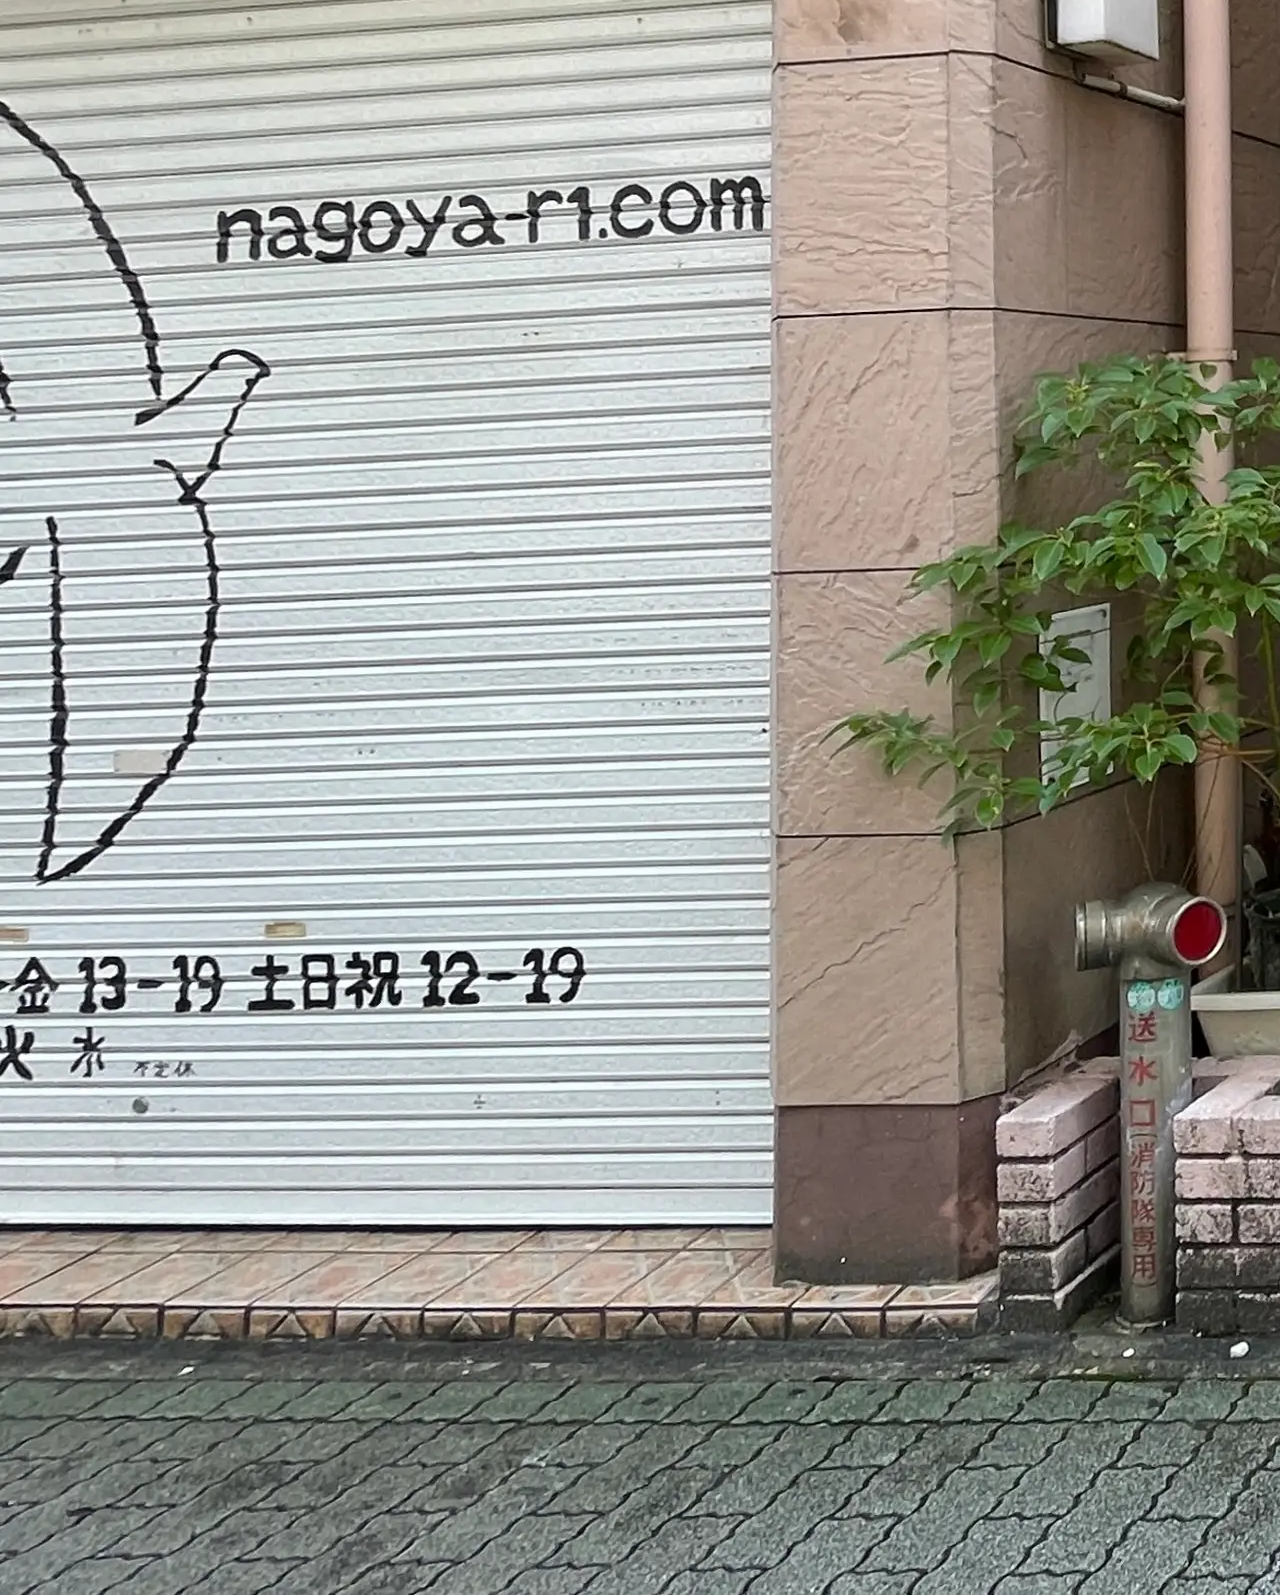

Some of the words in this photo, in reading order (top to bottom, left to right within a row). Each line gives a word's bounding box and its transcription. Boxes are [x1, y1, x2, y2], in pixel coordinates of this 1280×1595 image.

[216, 174, 769, 264] nagoya-r1.com
[0, 956, 60, 1014] 金
[77, 955, 225, 1014] 13-19
[248, 951, 402, 1012] 土日祝
[420, 946, 587, 1007] 12-19
[70, 1026, 105, 1078] 水
